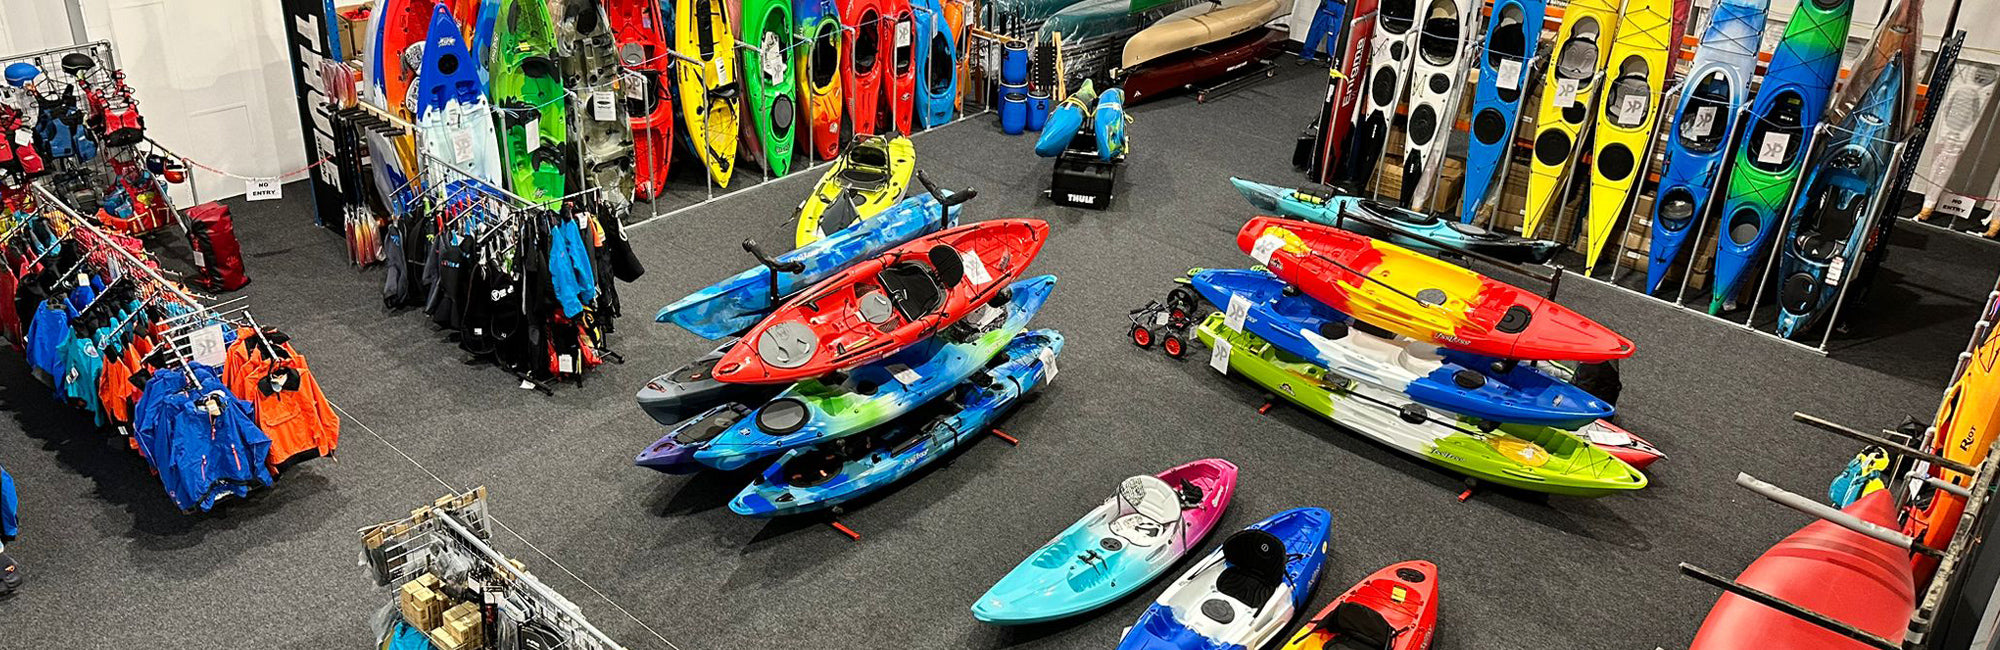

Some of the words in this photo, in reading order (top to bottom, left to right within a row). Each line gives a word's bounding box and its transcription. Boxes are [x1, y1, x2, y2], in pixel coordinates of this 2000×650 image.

[1342, 37, 1366, 107] Enigma
[1067, 193, 1096, 205] THULE
[1942, 204, 1966, 213] ENTRY
